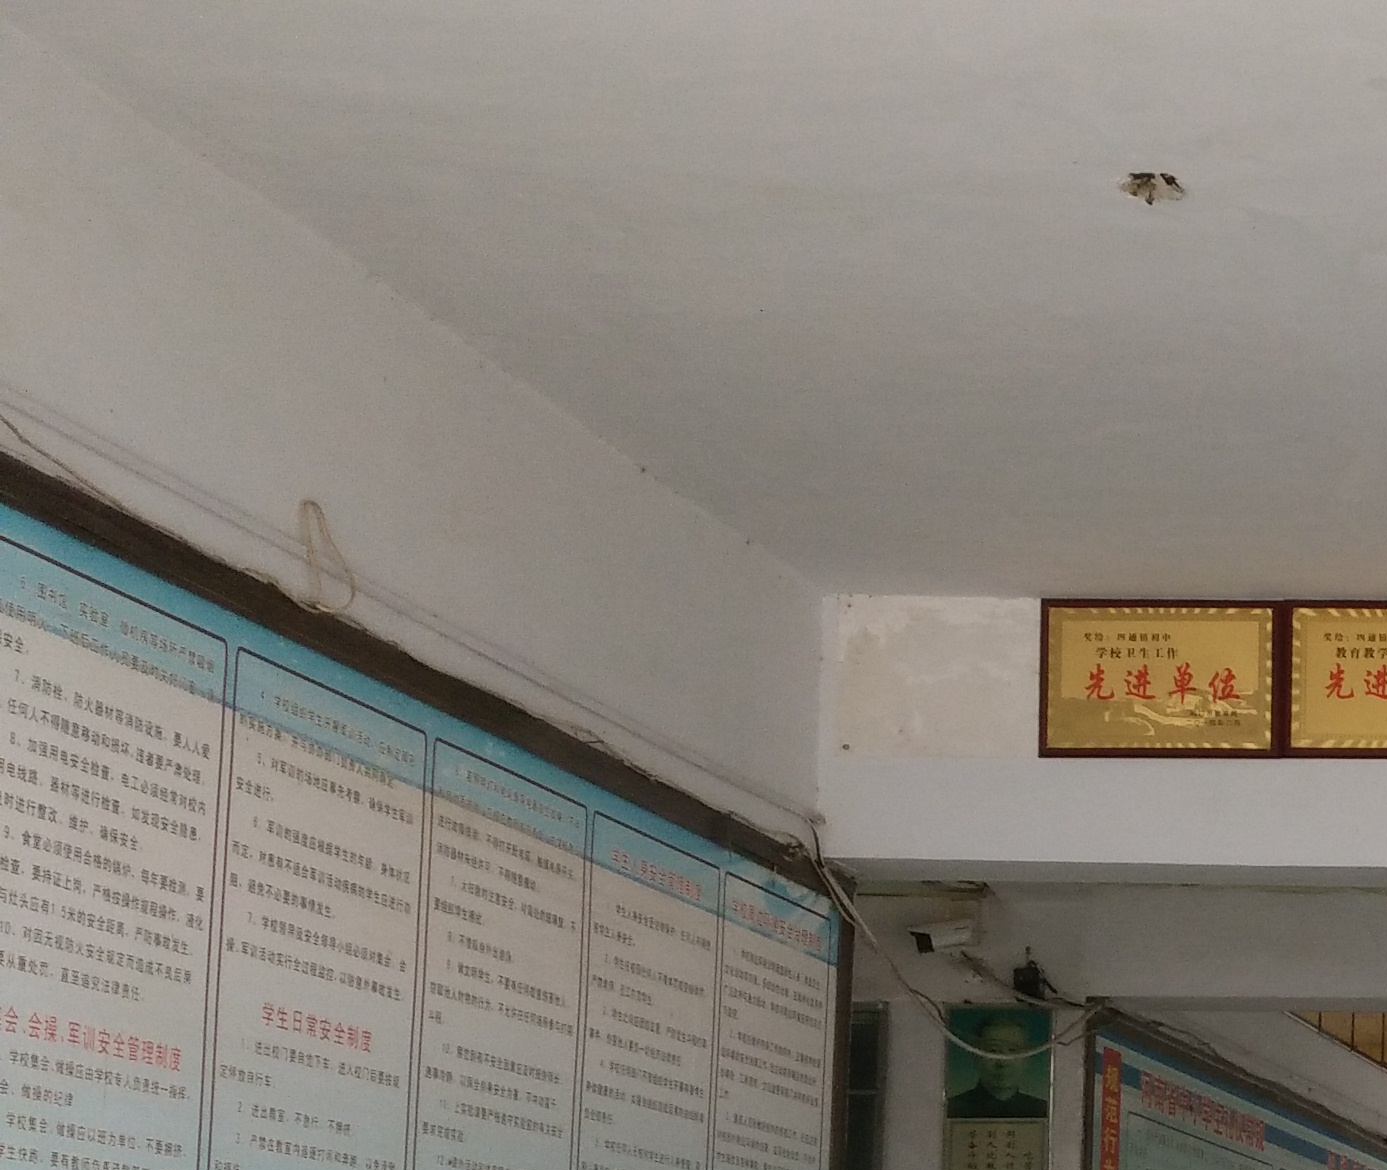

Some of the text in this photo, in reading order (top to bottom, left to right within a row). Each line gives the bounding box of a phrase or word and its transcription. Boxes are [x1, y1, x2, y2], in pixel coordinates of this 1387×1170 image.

[1096, 647, 1179, 659] 学校卫生工作
[1085, 662, 1241, 704] 先进单位
[0, 1002, 182, 1073] 会、会操、军训安全管理制度
[261, 999, 372, 1054] 学生日常安全制度
